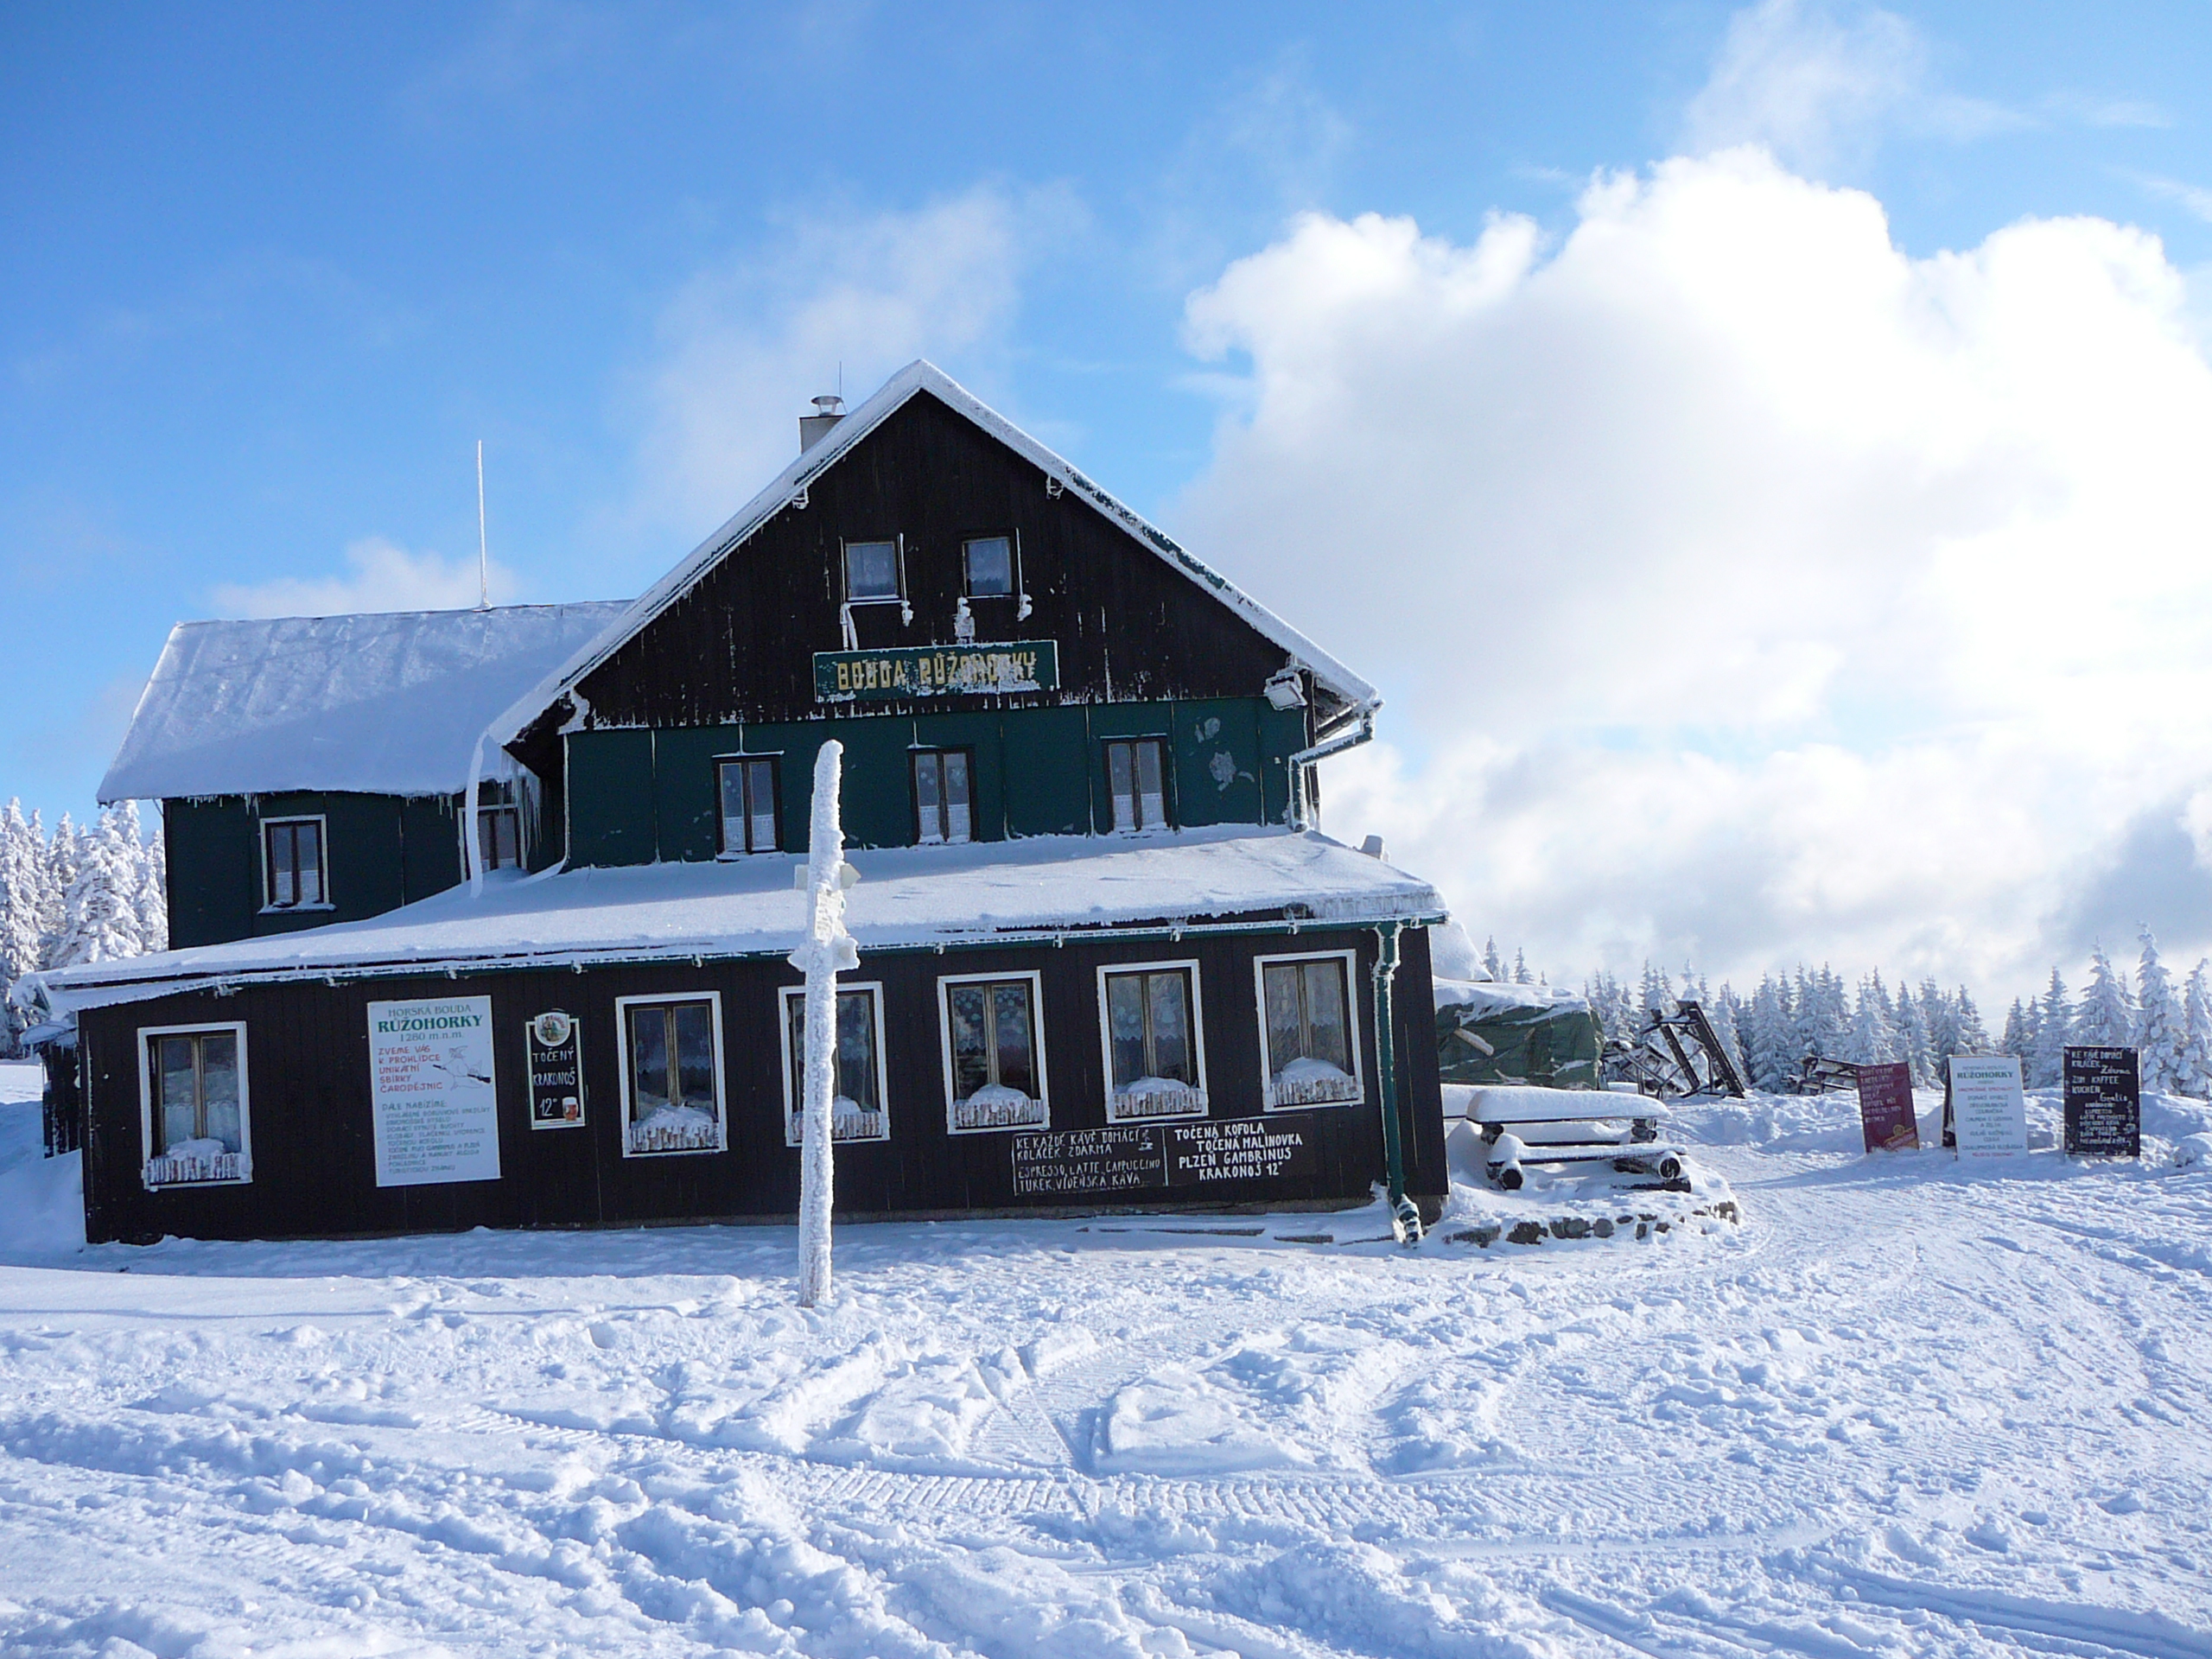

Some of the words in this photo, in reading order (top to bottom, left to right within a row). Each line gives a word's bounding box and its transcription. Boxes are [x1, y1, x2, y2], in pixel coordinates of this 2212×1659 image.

[836, 660, 906, 691] BOUDA
[388, 1005, 431, 1018] HORSKÁ
[435, 1004, 472, 1014] BOUDA
[378, 1014, 483, 1033] RŮŽOHORKY
[400, 1033, 425, 1042] 1280
[378, 1046, 410, 1056] ZVEME
[532, 1046, 575, 1063] TOČENÝ
[2072, 1051, 2082, 1059] KE
[532, 1067, 575, 1086] KRAKONOŠ
[2072, 1085, 2101, 1094] KUCHEN
[1016, 1137, 1029, 1149] KE
[1033, 1132, 1065, 1148] KAŽDÉ
[1071, 1130, 1096, 1145] KÁVĚ
[1102, 1128, 1139, 1144] DOMÁCÍ
[1174, 1122, 1219, 1141] TOČENÁ
[1224, 1122, 1265, 1137] KOFOLA
[1017, 1147, 1061, 1161] KOLÁČEK
[1068, 1143, 1113, 1157] ZDARMA
[1196, 1136, 1240, 1153] TOČENÁ
[1106, 1159, 1160, 1173] CAPPUCCINO
[1179, 1150, 1217, 1169] PLZEŇ
[1224, 1147, 1292, 1165] GAMBRINUS
[1112, 1171, 1141, 1186] KÁVA
[1198, 1161, 1262, 1181] KRAKONOŠ
